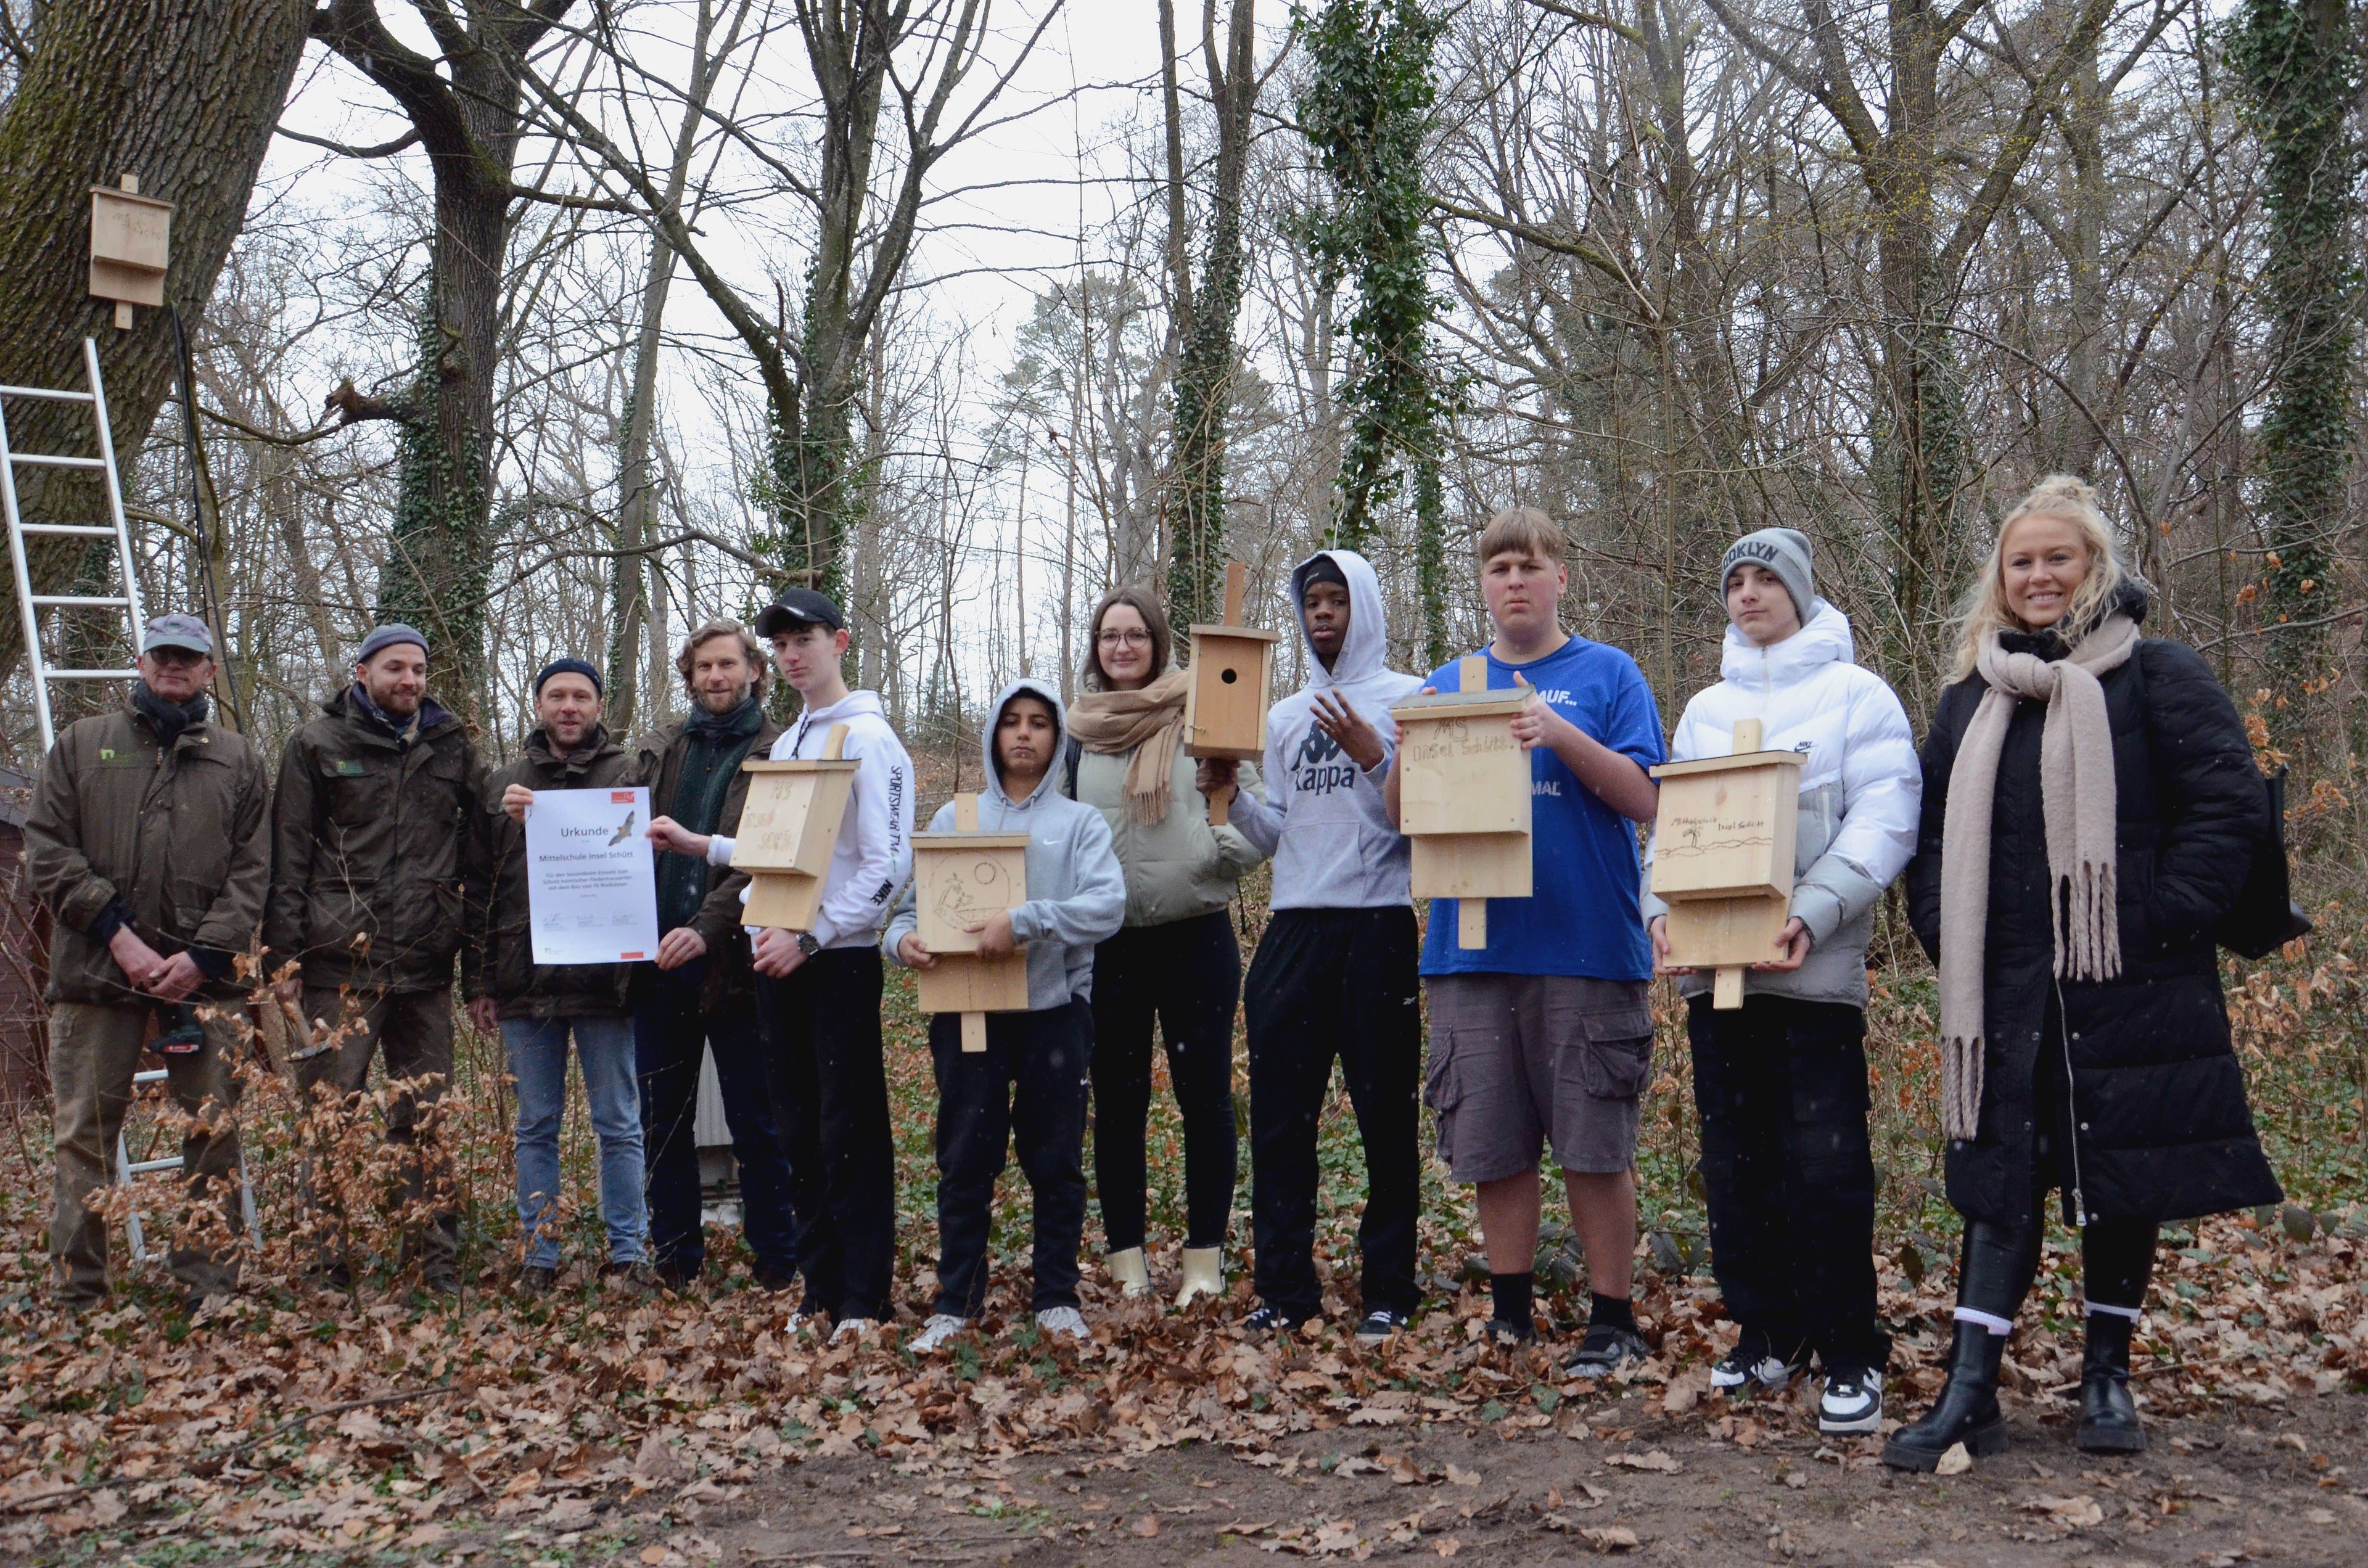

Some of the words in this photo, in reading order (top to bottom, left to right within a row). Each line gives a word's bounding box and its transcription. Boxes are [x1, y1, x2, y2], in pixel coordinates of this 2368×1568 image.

[1723, 541, 1779, 570] OOKLYN
[889, 765, 903, 832] SPORTSWEAR
[561, 826, 609, 837] Urkunde
[539, 853, 586, 862] Mittelschule
[588, 852, 607, 860] Insel
[609, 850, 633, 859] Schütt
[870, 879, 894, 906] NIKE
